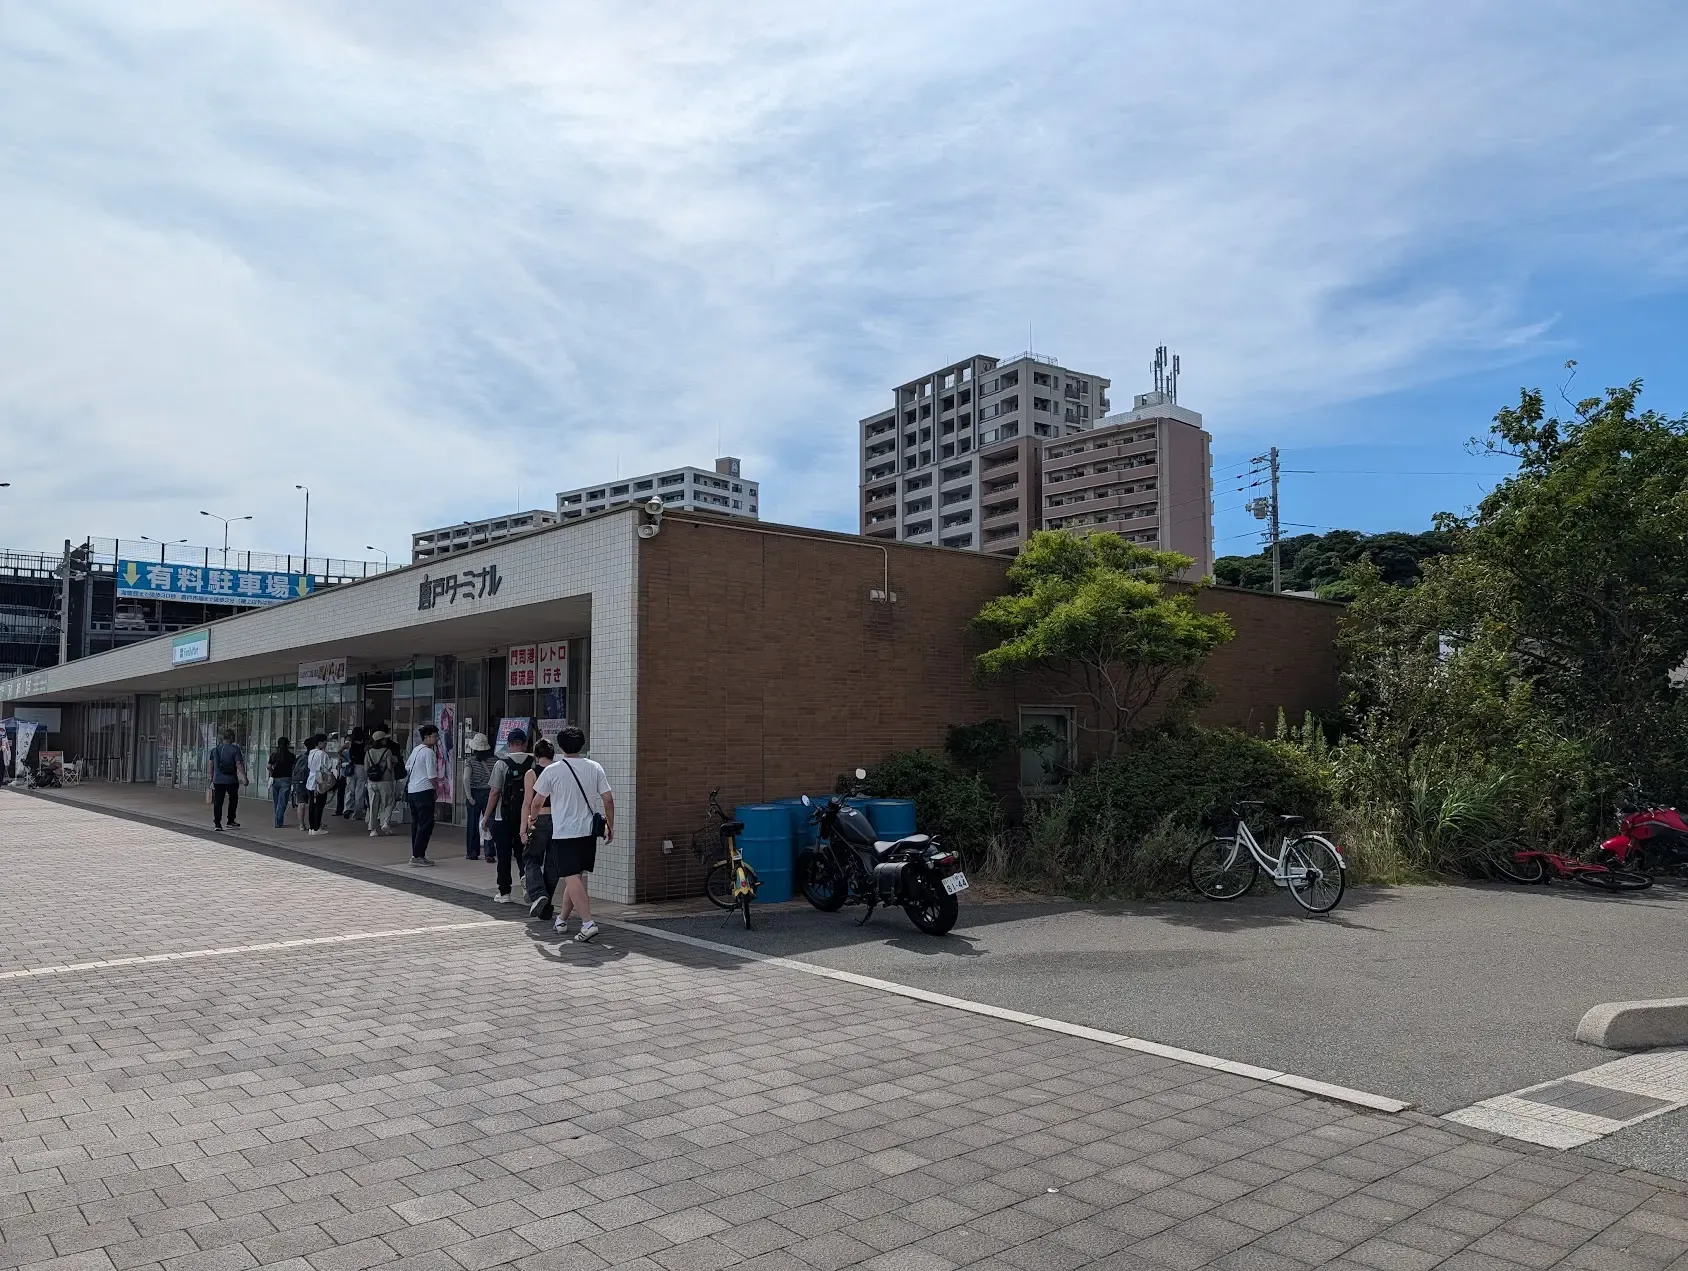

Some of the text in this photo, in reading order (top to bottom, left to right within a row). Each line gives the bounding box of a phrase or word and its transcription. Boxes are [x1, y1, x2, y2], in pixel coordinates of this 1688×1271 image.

[146, 565, 290, 598] 有料駐車場
[417, 565, 503, 611] 唐戸ターミナル
[510, 645, 566, 666] 門司港 レトロ
[543, 667, 562, 685] 行き
